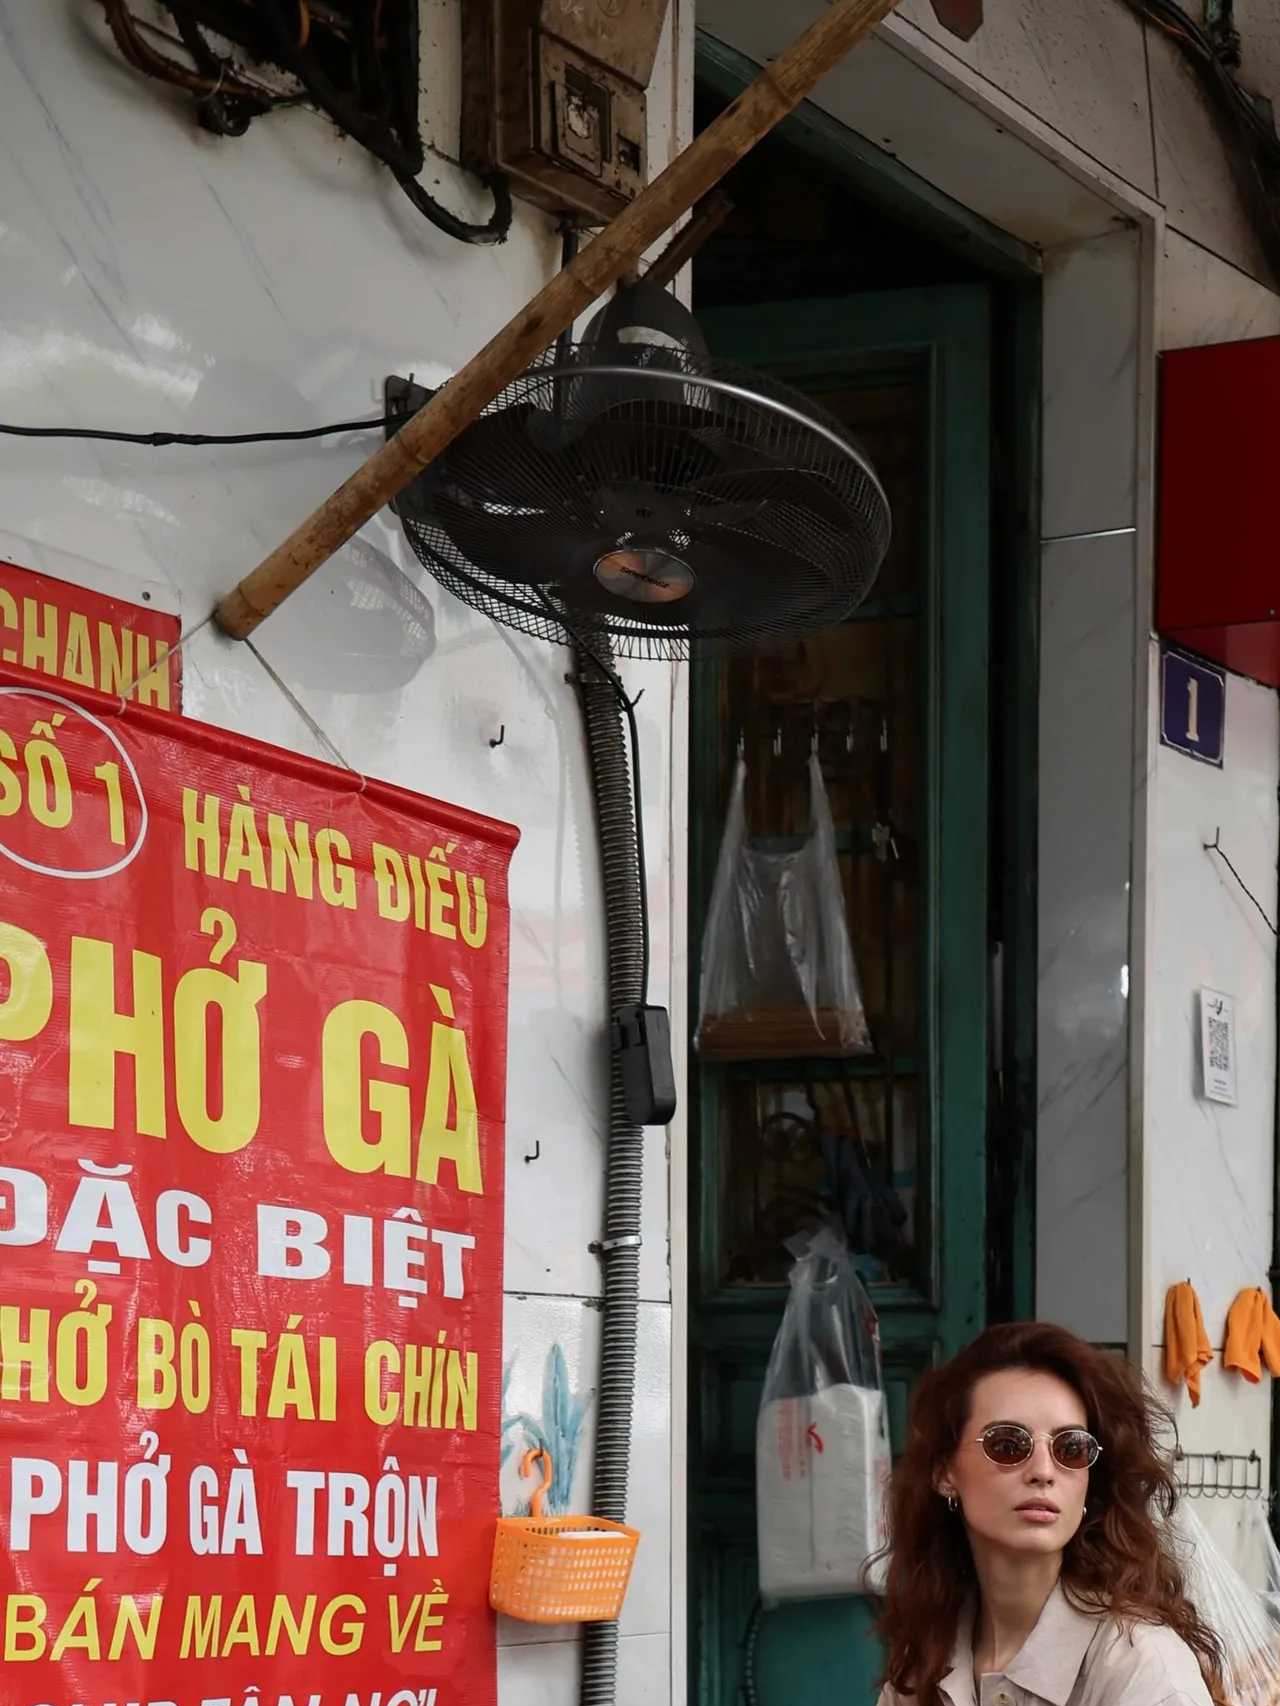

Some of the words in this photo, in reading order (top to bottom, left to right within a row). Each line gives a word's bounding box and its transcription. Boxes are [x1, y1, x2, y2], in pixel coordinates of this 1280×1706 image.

[0, 587, 170, 711] CHANH
[1185, 676, 1199, 742] 1
[0, 713, 73, 828] SỐ
[94, 761, 126, 846] 1
[182, 785, 357, 910] HÀNG
[374, 843, 488, 948] ĐIẾU
[0, 907, 267, 1153] PHỞ
[322, 983, 483, 1195] GÀ
[0, 1159, 212, 1274] ĐẶC
[257, 1205, 475, 1309] BIỆT
[137, 1300, 210, 1414] BÒ
[231, 1314, 335, 1422] TÁI
[364, 1330, 479, 1431] CHÍN
[10, 1431, 170, 1555] PHỞ
[189, 1448, 263, 1556] GÀ
[287, 1456, 438, 1576] TRỘN
[4, 1578, 161, 1662] BÁN
[179, 1594, 366, 1660] MANG
[388, 1579, 450, 1653] VỀ
